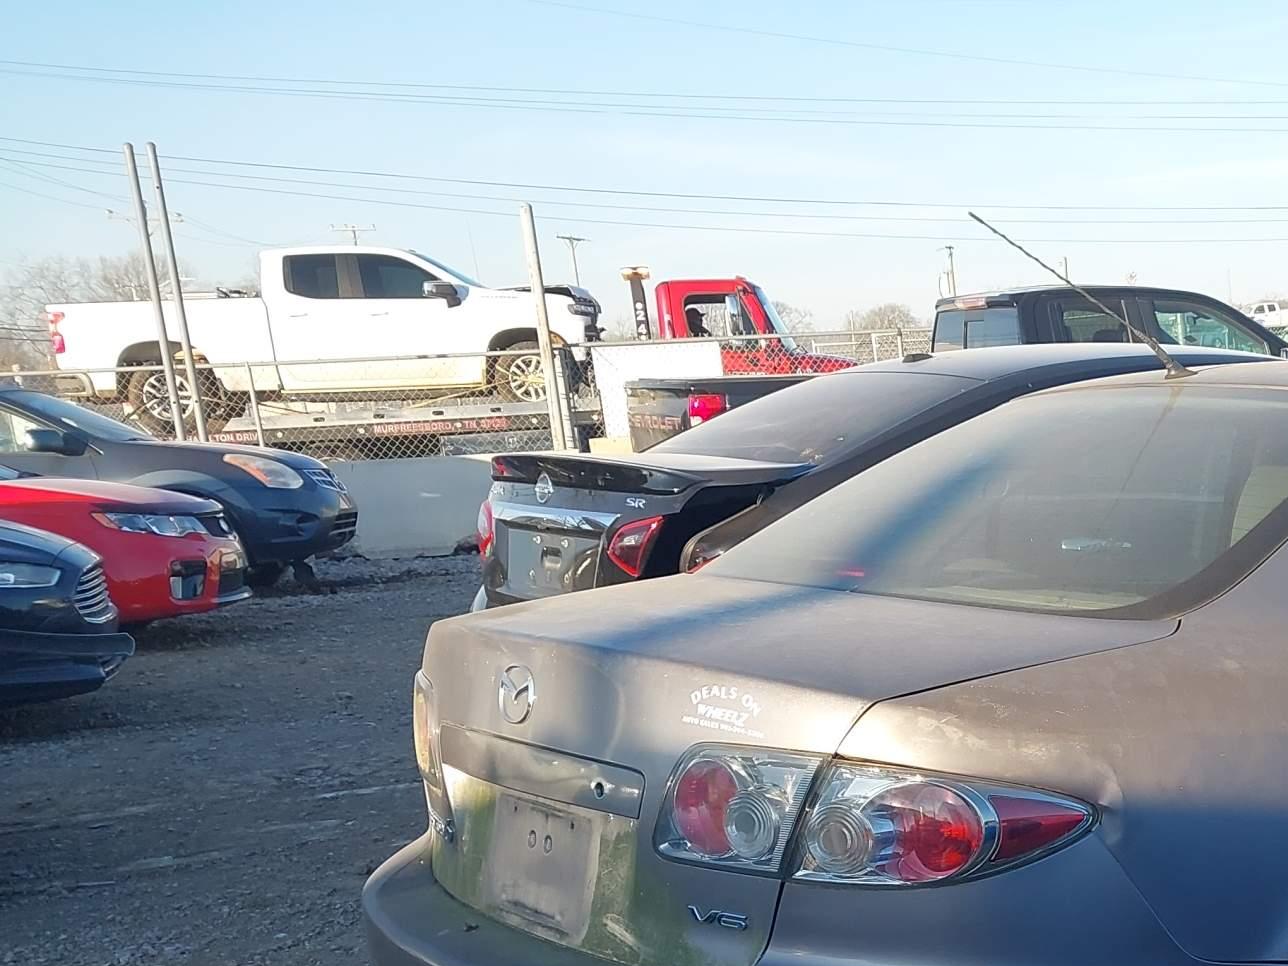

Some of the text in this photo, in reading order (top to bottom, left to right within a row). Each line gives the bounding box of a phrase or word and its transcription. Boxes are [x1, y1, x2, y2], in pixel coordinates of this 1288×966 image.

[235, 431, 257, 442] DRIV
[625, 496, 646, 509] SR
[689, 685, 763, 718] DEALS ON
[697, 702, 751, 728] WHEELZ
[687, 904, 748, 931] V6
